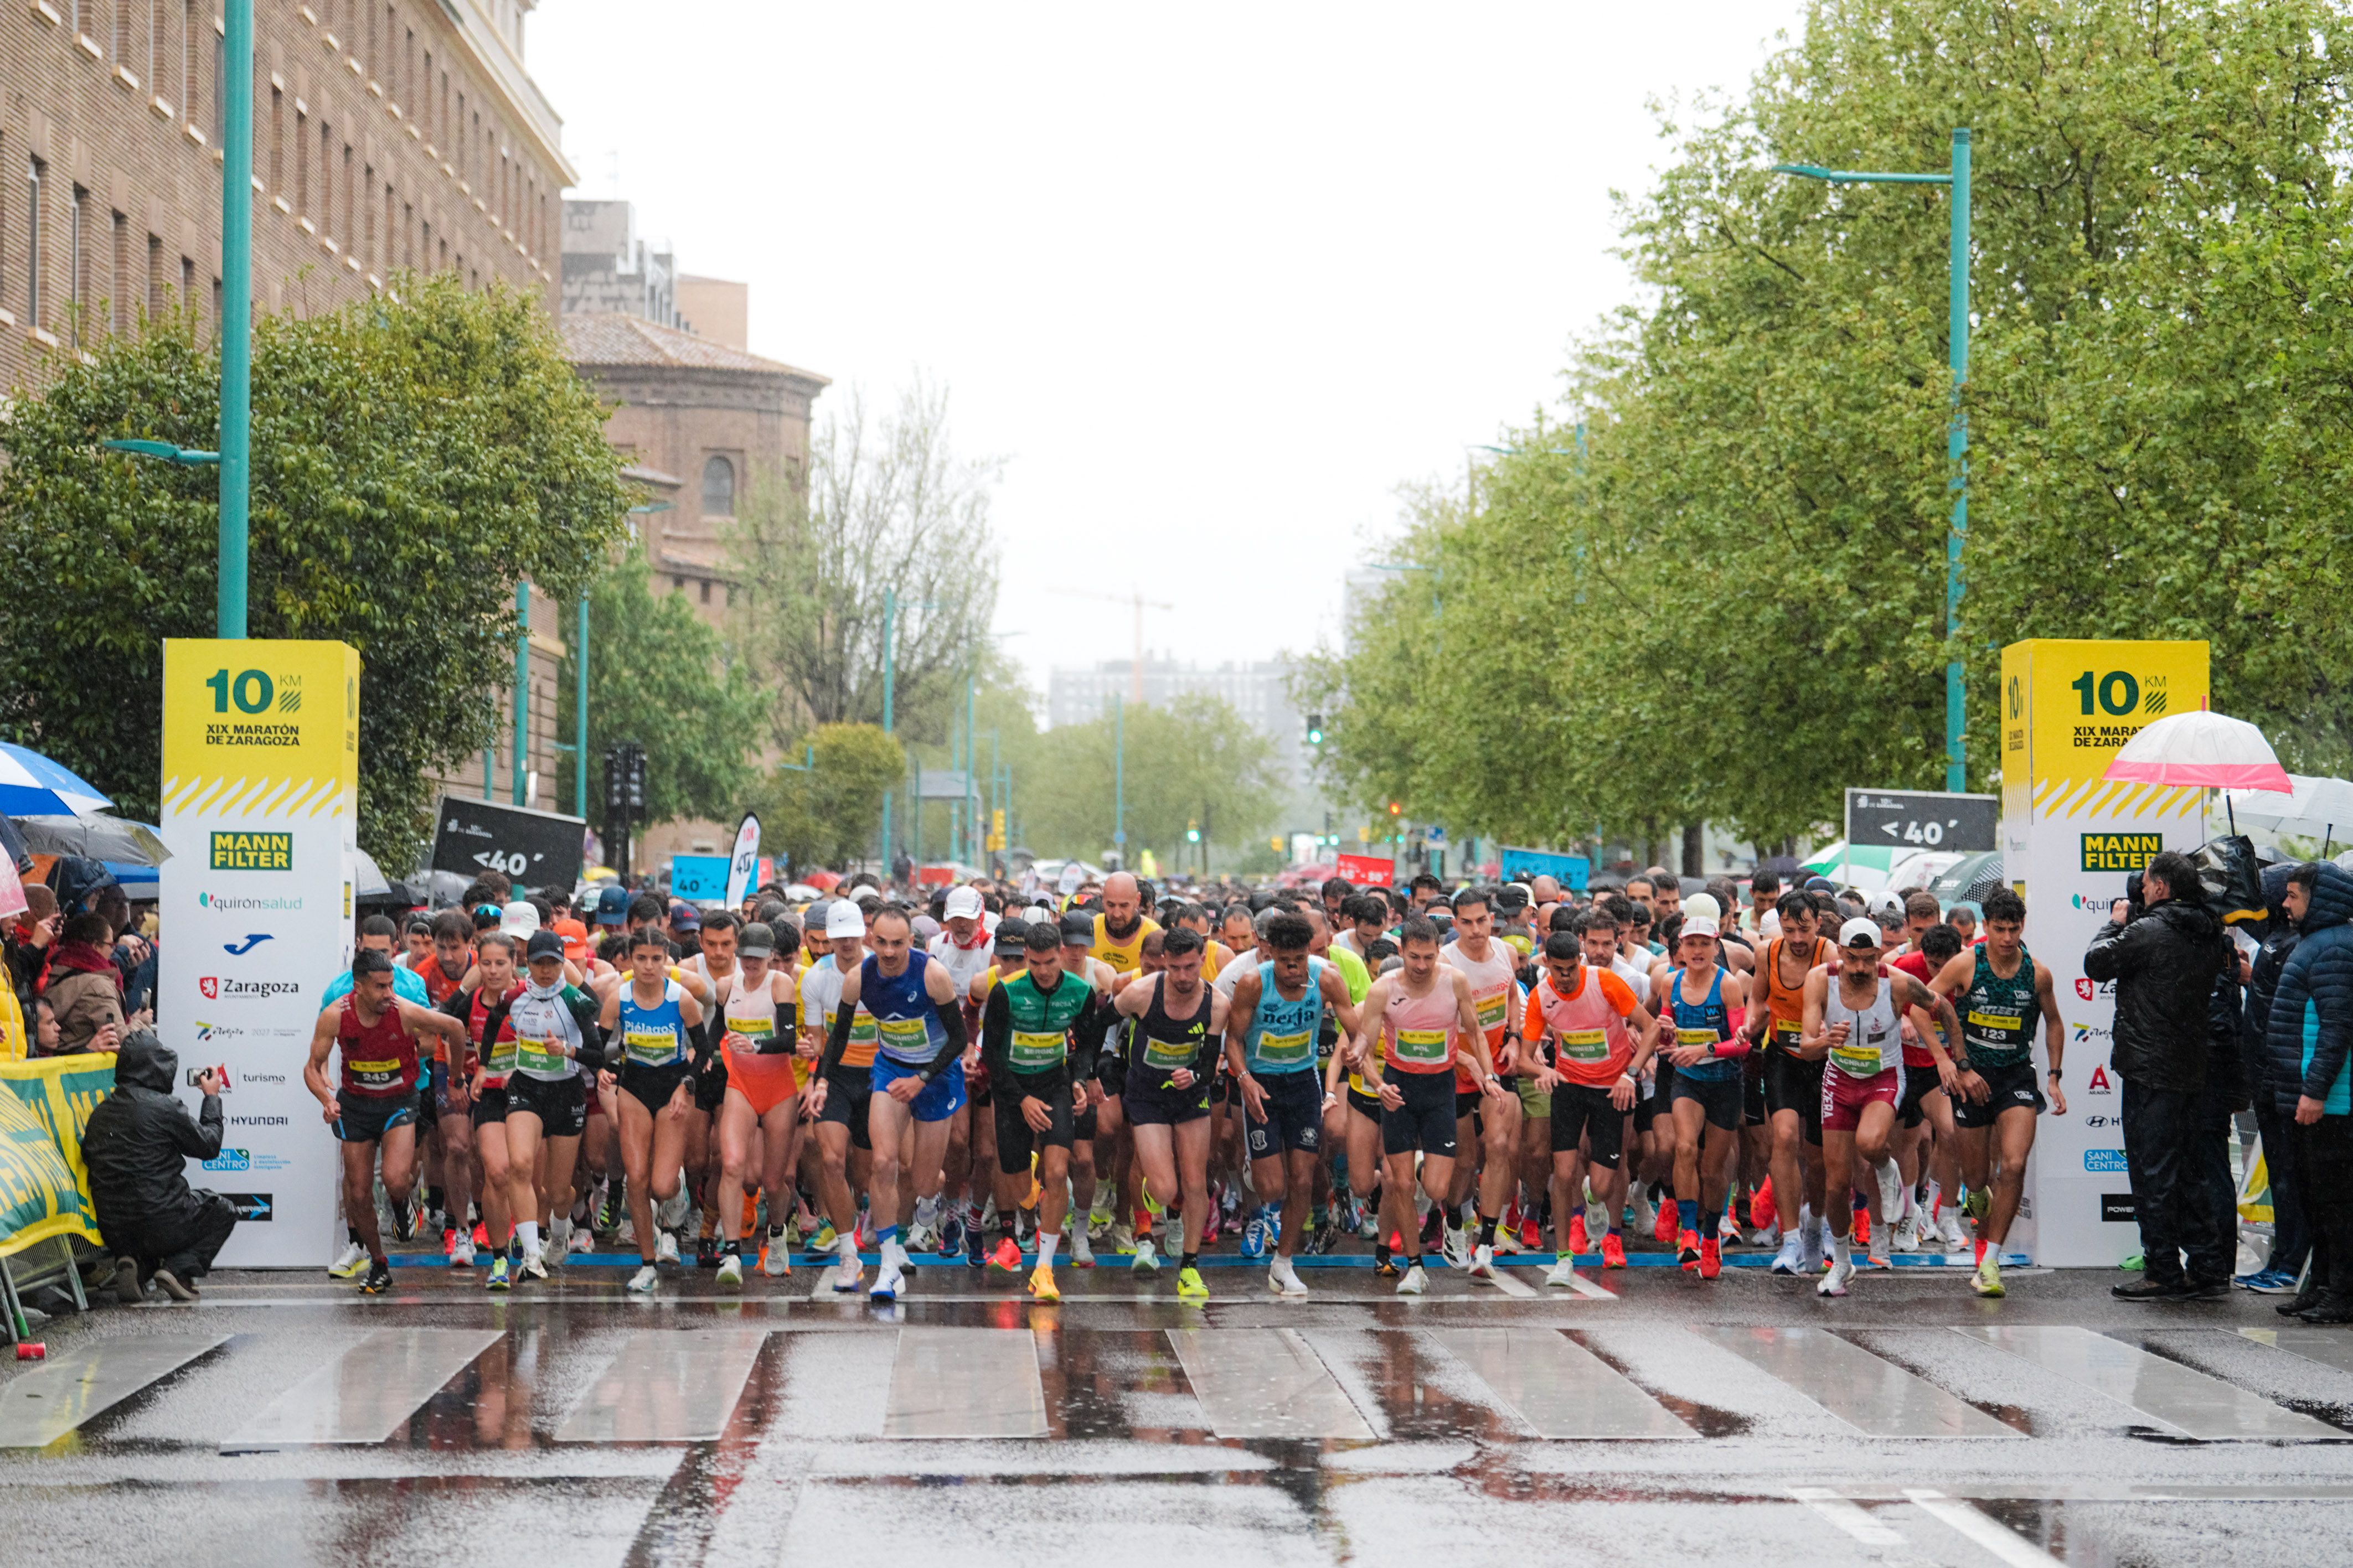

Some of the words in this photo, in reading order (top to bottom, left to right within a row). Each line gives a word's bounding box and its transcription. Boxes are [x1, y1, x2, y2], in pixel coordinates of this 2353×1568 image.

[207, 669, 273, 714] 10
[280, 675, 301, 687] KM
[2072, 671, 2139, 716] 10
[2145, 676, 2166, 687] KM
[207, 724, 229, 734] XIX
[234, 723, 299, 734] MARATÓN
[2074, 727, 2096, 736] XIX
[207, 736, 223, 745] DE
[226, 736, 300, 746] ZARAGOZA
[2074, 738, 2091, 747] DE
[2094, 738, 2129, 747] ZARA
[215, 834, 288, 851] MANN
[2086, 836, 2158, 851] MANN
[214, 851, 288, 868] FILTER
[214, 897, 302, 913] quirónsalud
[224, 979, 299, 998] Zaragoza
[1262, 1007, 1315, 1027] nerja
[1980, 1028, 2006, 1041] 123
[244, 1073, 285, 1083] turismo
[363, 1072, 390, 1082] 243
[231, 1116, 288, 1125] HYUNDAI
[2087, 1152, 2112, 1161] SANI
[203, 1161, 248, 1170] CENTRO
